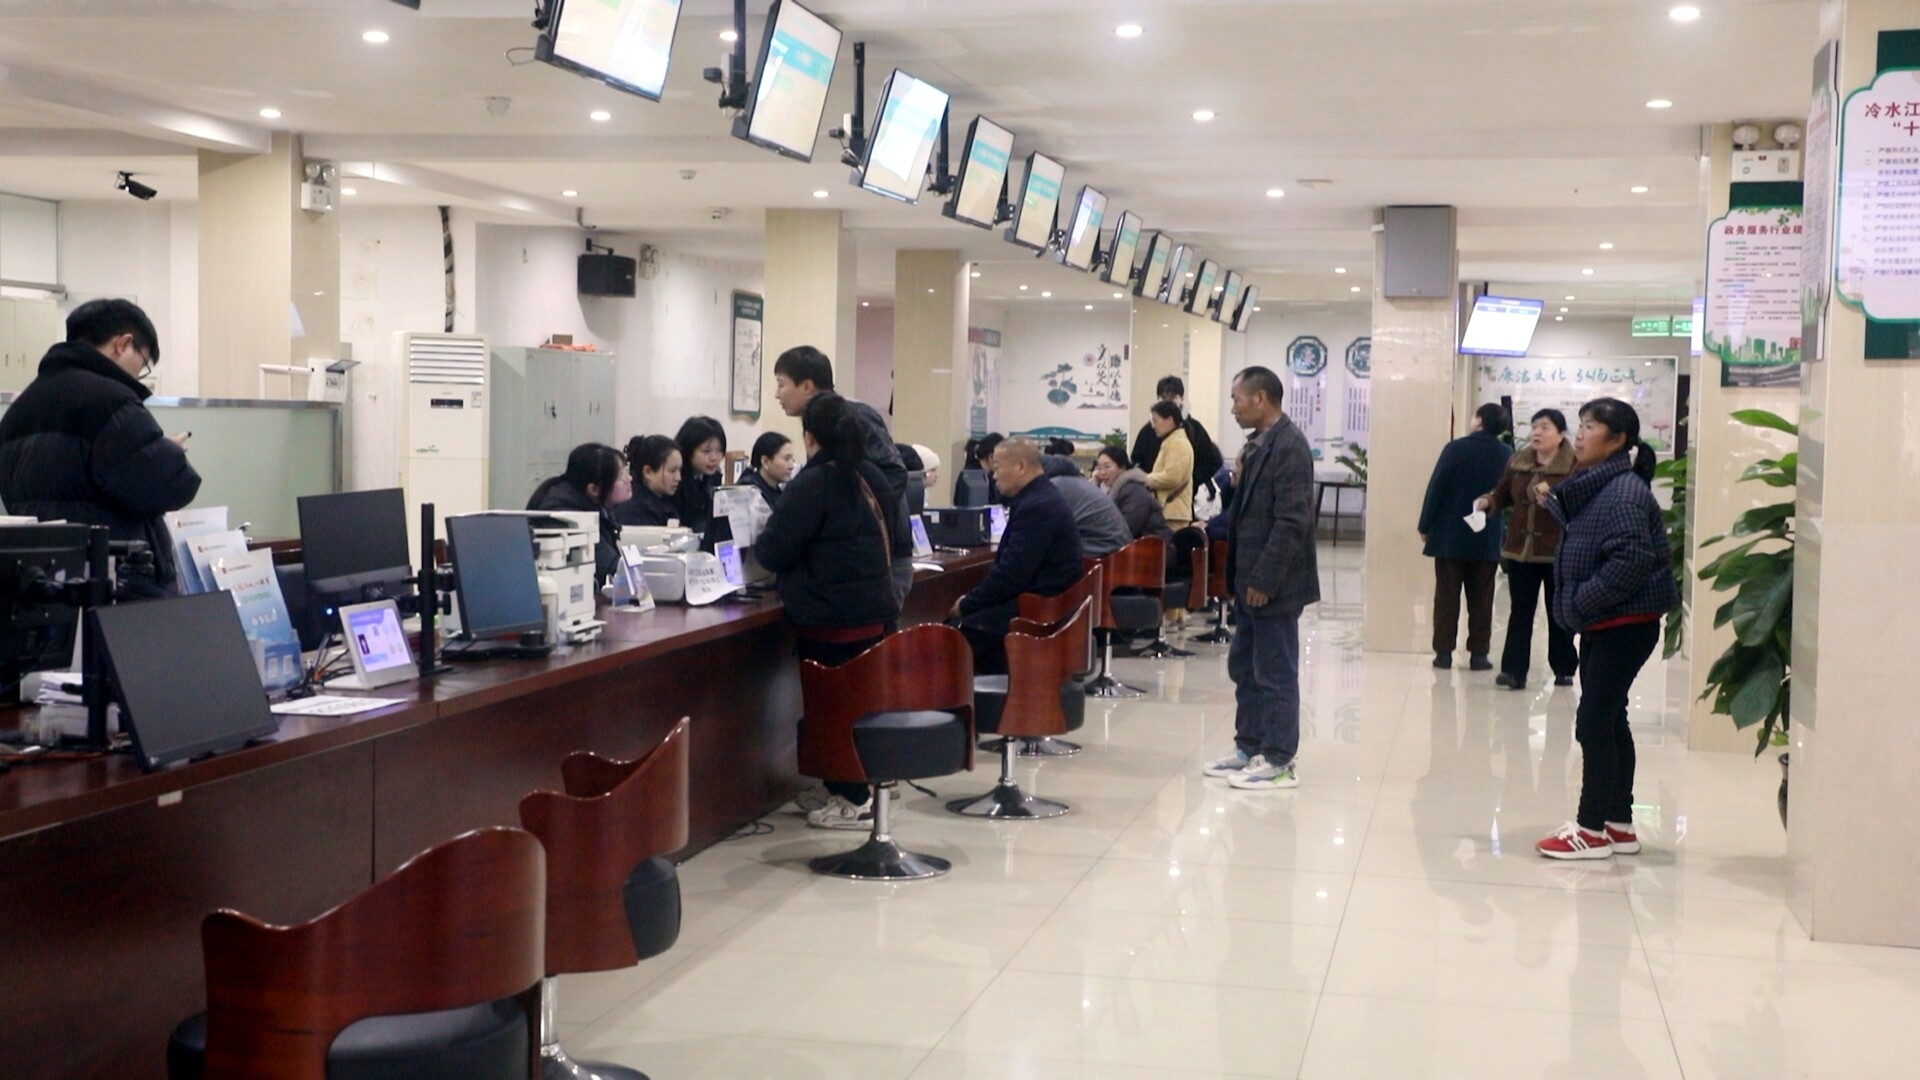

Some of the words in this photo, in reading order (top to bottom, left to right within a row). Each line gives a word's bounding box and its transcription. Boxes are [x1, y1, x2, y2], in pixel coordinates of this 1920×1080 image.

[1865, 102, 1920, 118] 冷水江
[1498, 366, 1567, 384] 廉洁文化
[1576, 366, 1642, 385] 弘扬正气
